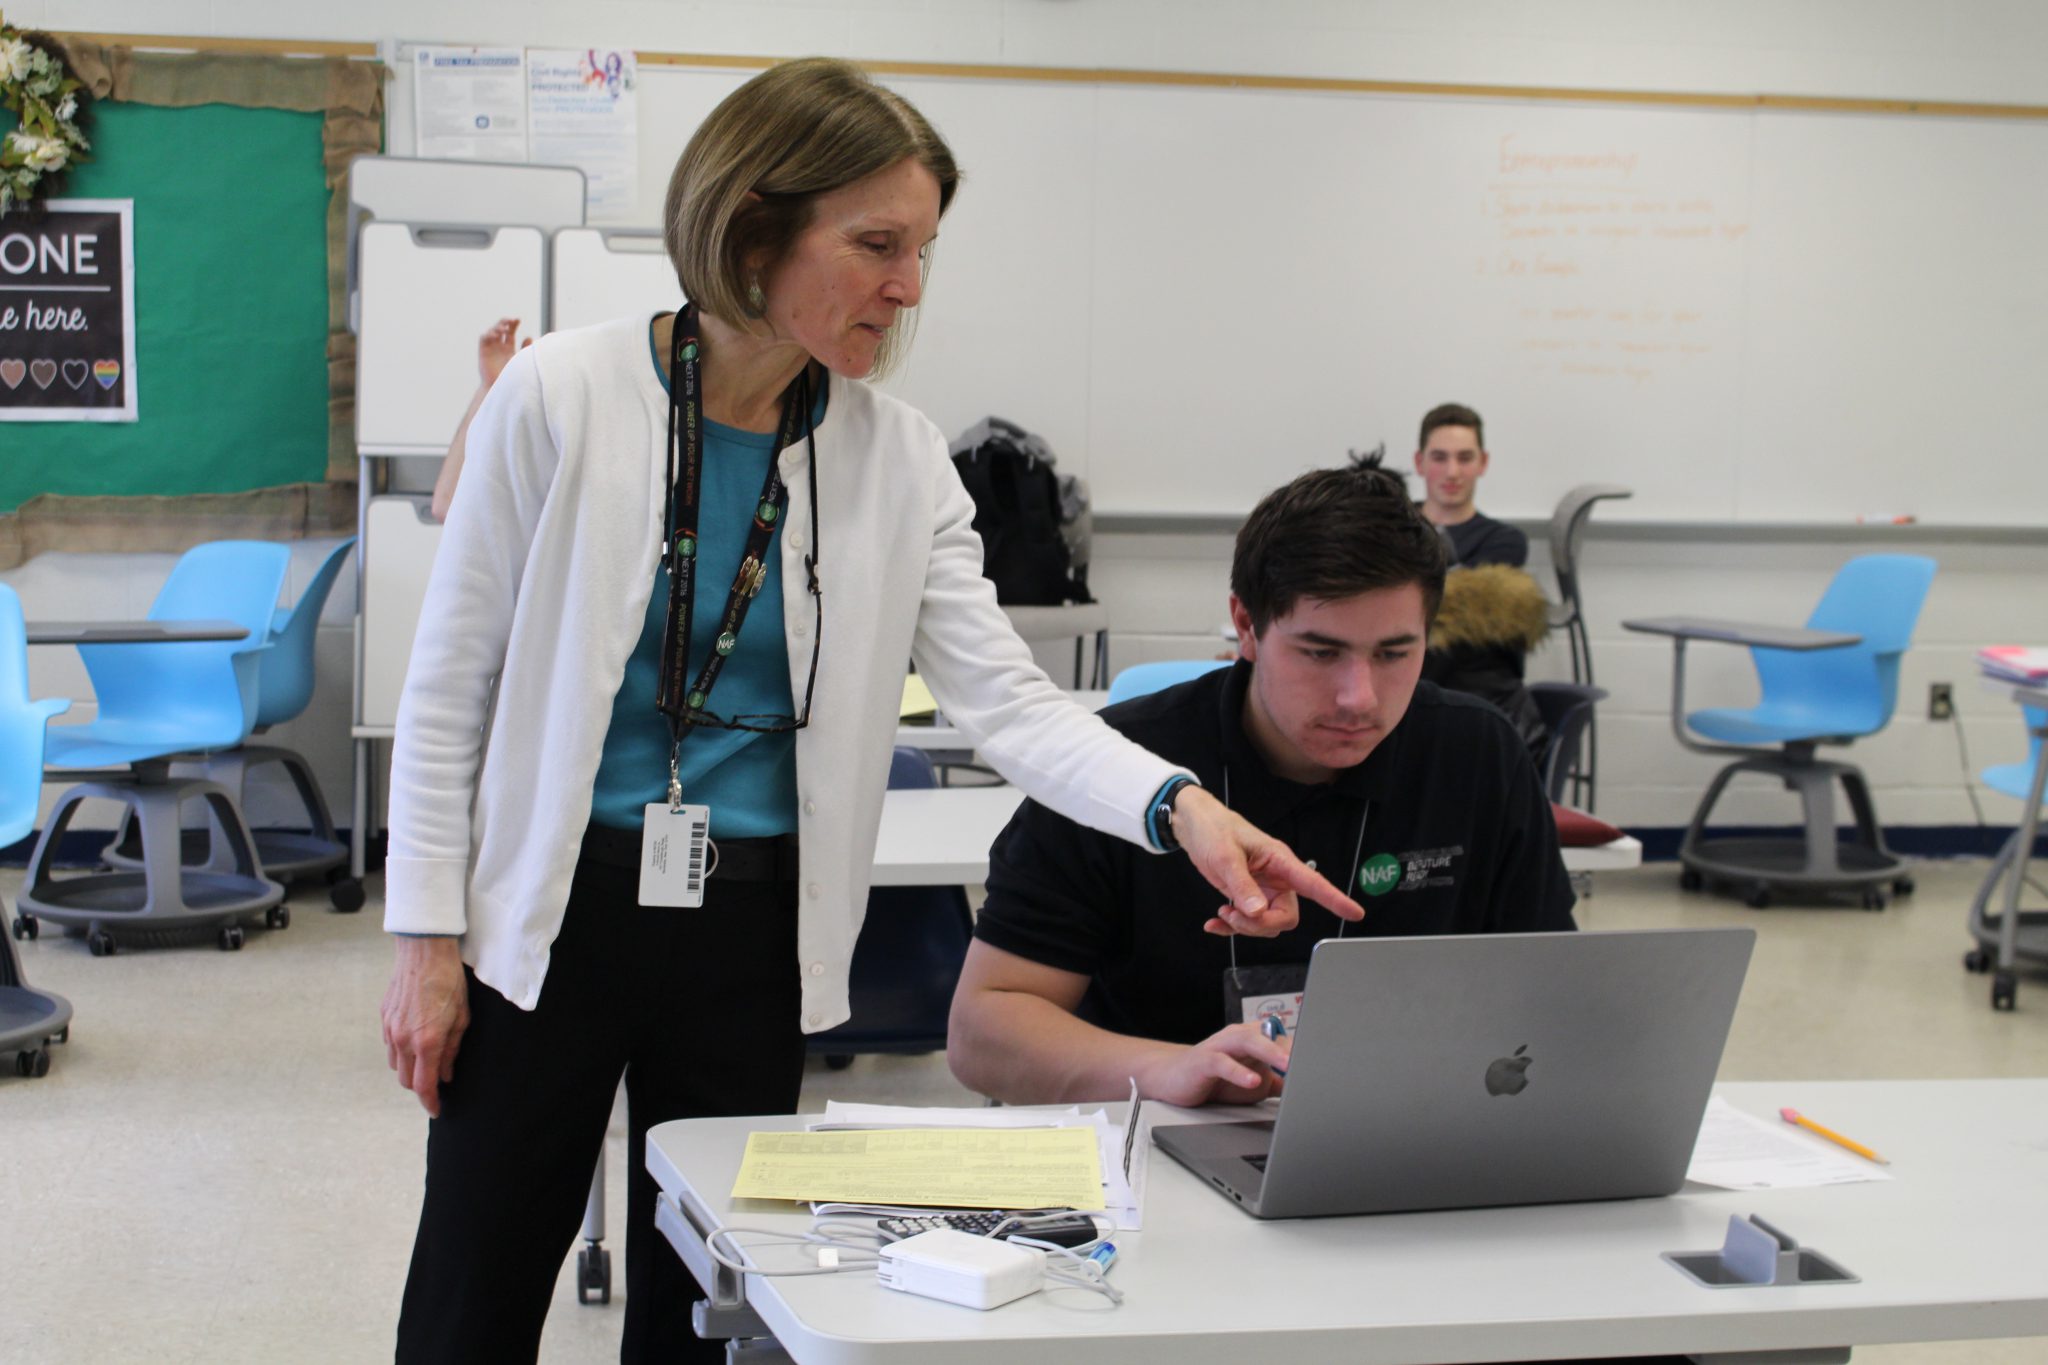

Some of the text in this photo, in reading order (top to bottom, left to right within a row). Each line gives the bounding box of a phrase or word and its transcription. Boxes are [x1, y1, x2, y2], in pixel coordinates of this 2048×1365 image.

[26, 300, 88, 330] here.
[686, 400, 696, 429] POWER
[687, 429, 696, 442] UP
[681, 557, 690, 578] NEXT
[680, 579, 688, 597] 2016
[678, 603, 687, 632] POWER
[718, 639, 735, 649] NAF
[1361, 864, 1398, 886] NAF
